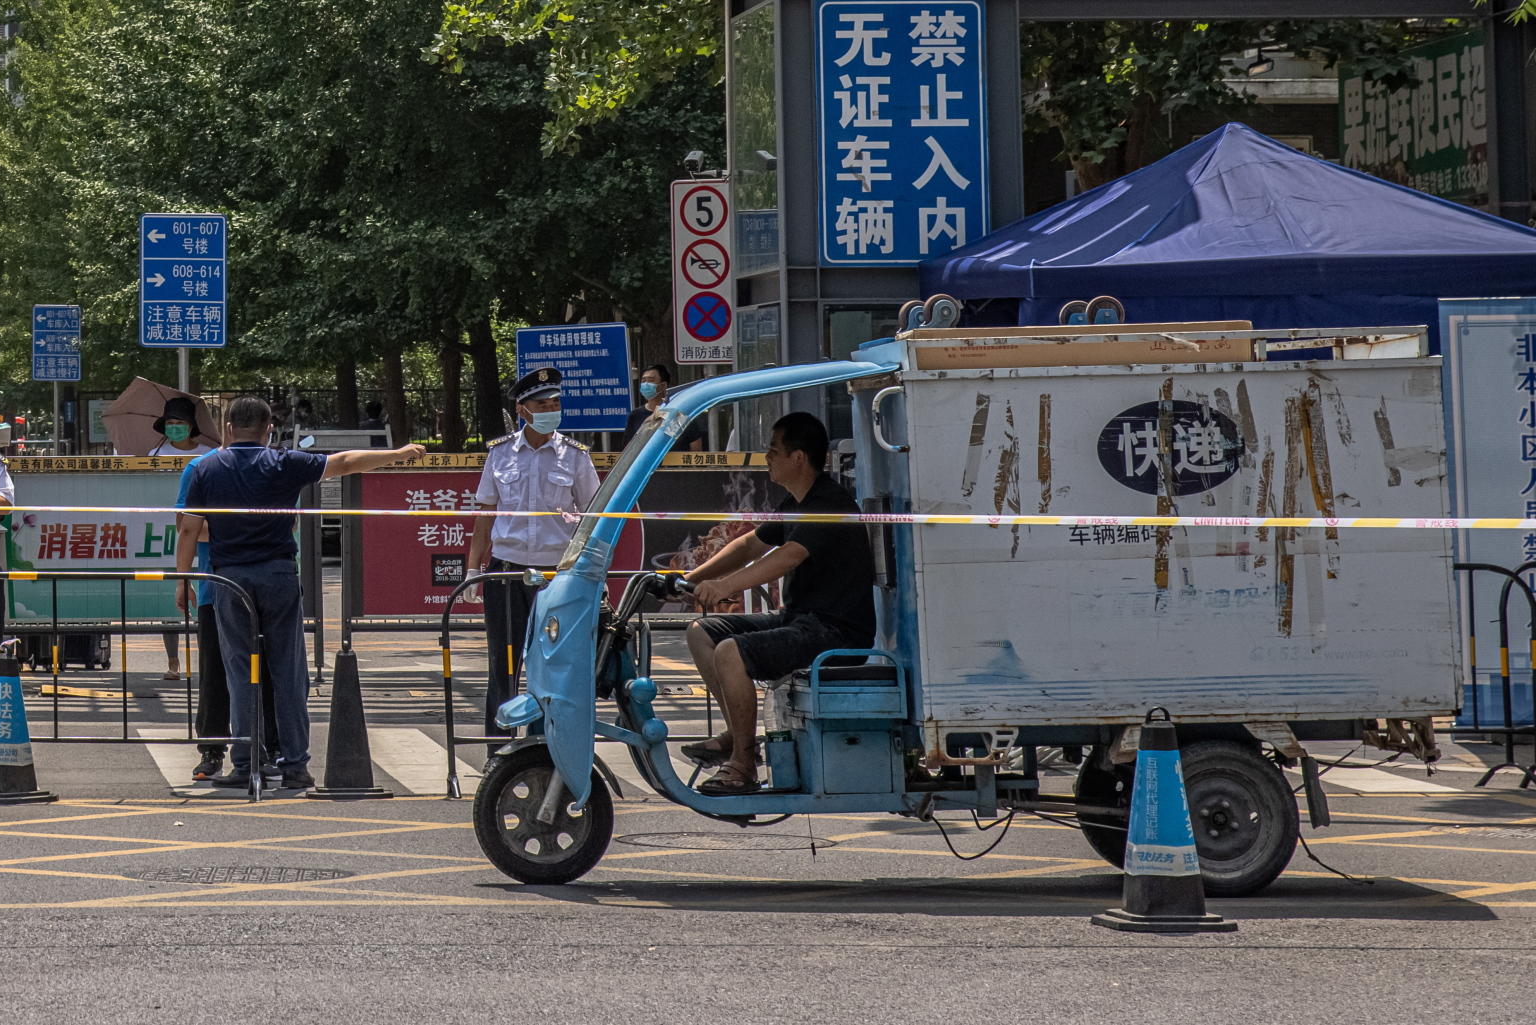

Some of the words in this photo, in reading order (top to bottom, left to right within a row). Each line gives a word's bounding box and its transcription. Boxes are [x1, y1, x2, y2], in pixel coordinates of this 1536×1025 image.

[833, 12, 894, 256] 无证车辆
[908, 10, 971, 255] 禁止入内
[695, 196, 714, 227] 5
[172, 222, 219, 235] 601-607
[182, 238, 208, 254] 号楼
[172, 264, 220, 278] 608-614
[182, 280, 208, 296] 号楼
[147, 305, 221, 323] 注意车辆
[146, 324, 221, 342] 减速慢行
[539, 331, 602, 347] 停车场使用管理规定
[681, 345, 733, 359] 消防通道
[1118, 420, 1226, 477] 快递
[682, 454, 728, 465] 请勿跟随
[37, 522, 127, 559] 消暑热
[1145, 757, 1159, 841] 互联网代理记账
